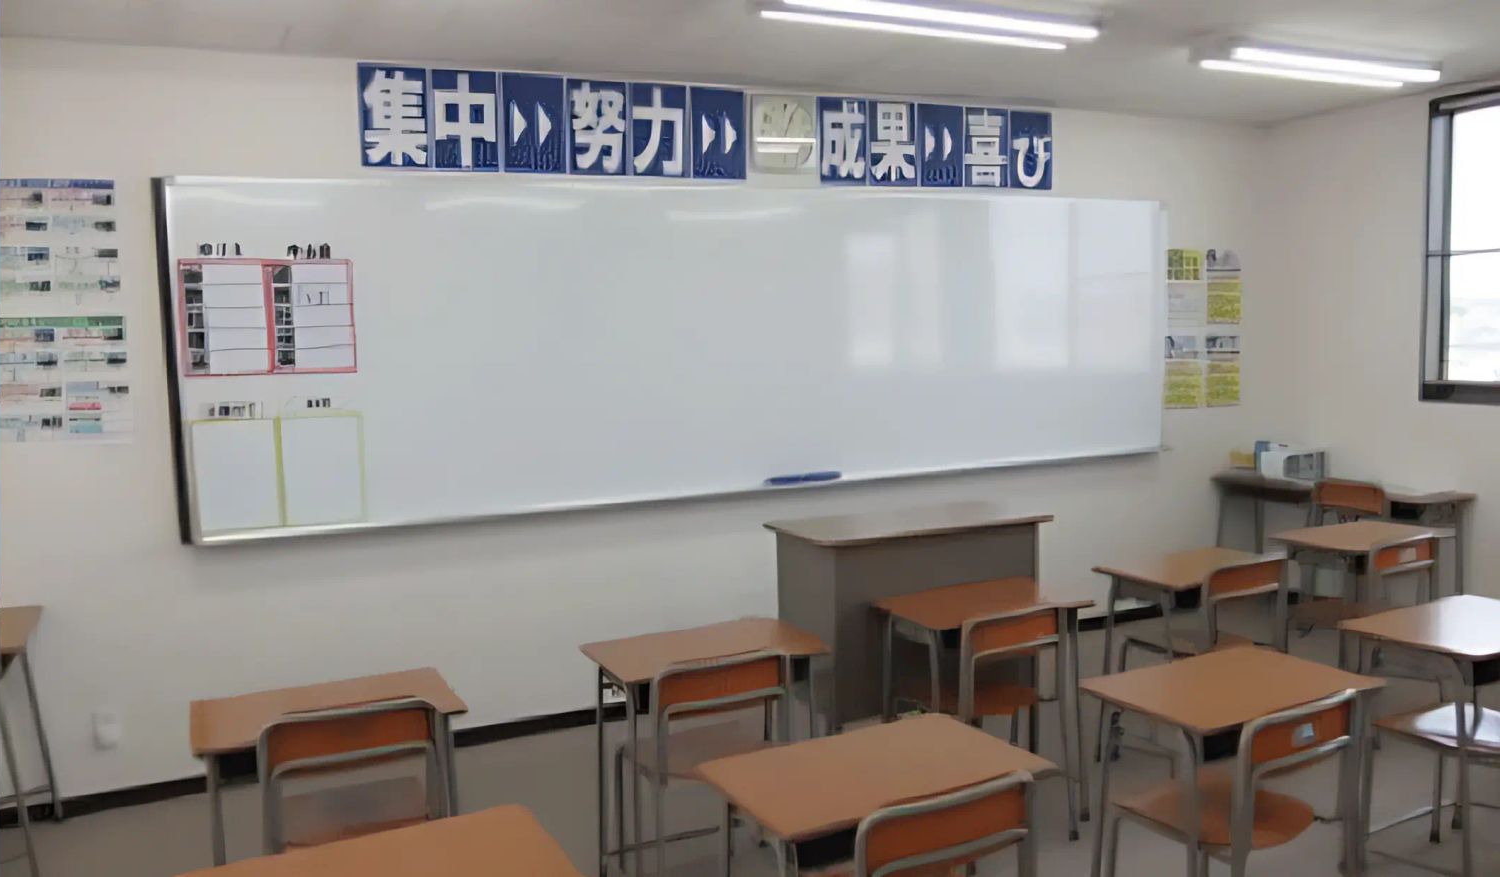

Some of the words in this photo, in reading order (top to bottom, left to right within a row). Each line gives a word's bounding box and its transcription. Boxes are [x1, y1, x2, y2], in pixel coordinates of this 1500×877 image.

[363, 69, 497, 169] 集中
[572, 82, 684, 176] 努力
[822, 100, 916, 181] 成果
[964, 109, 1051, 188] 喜び
